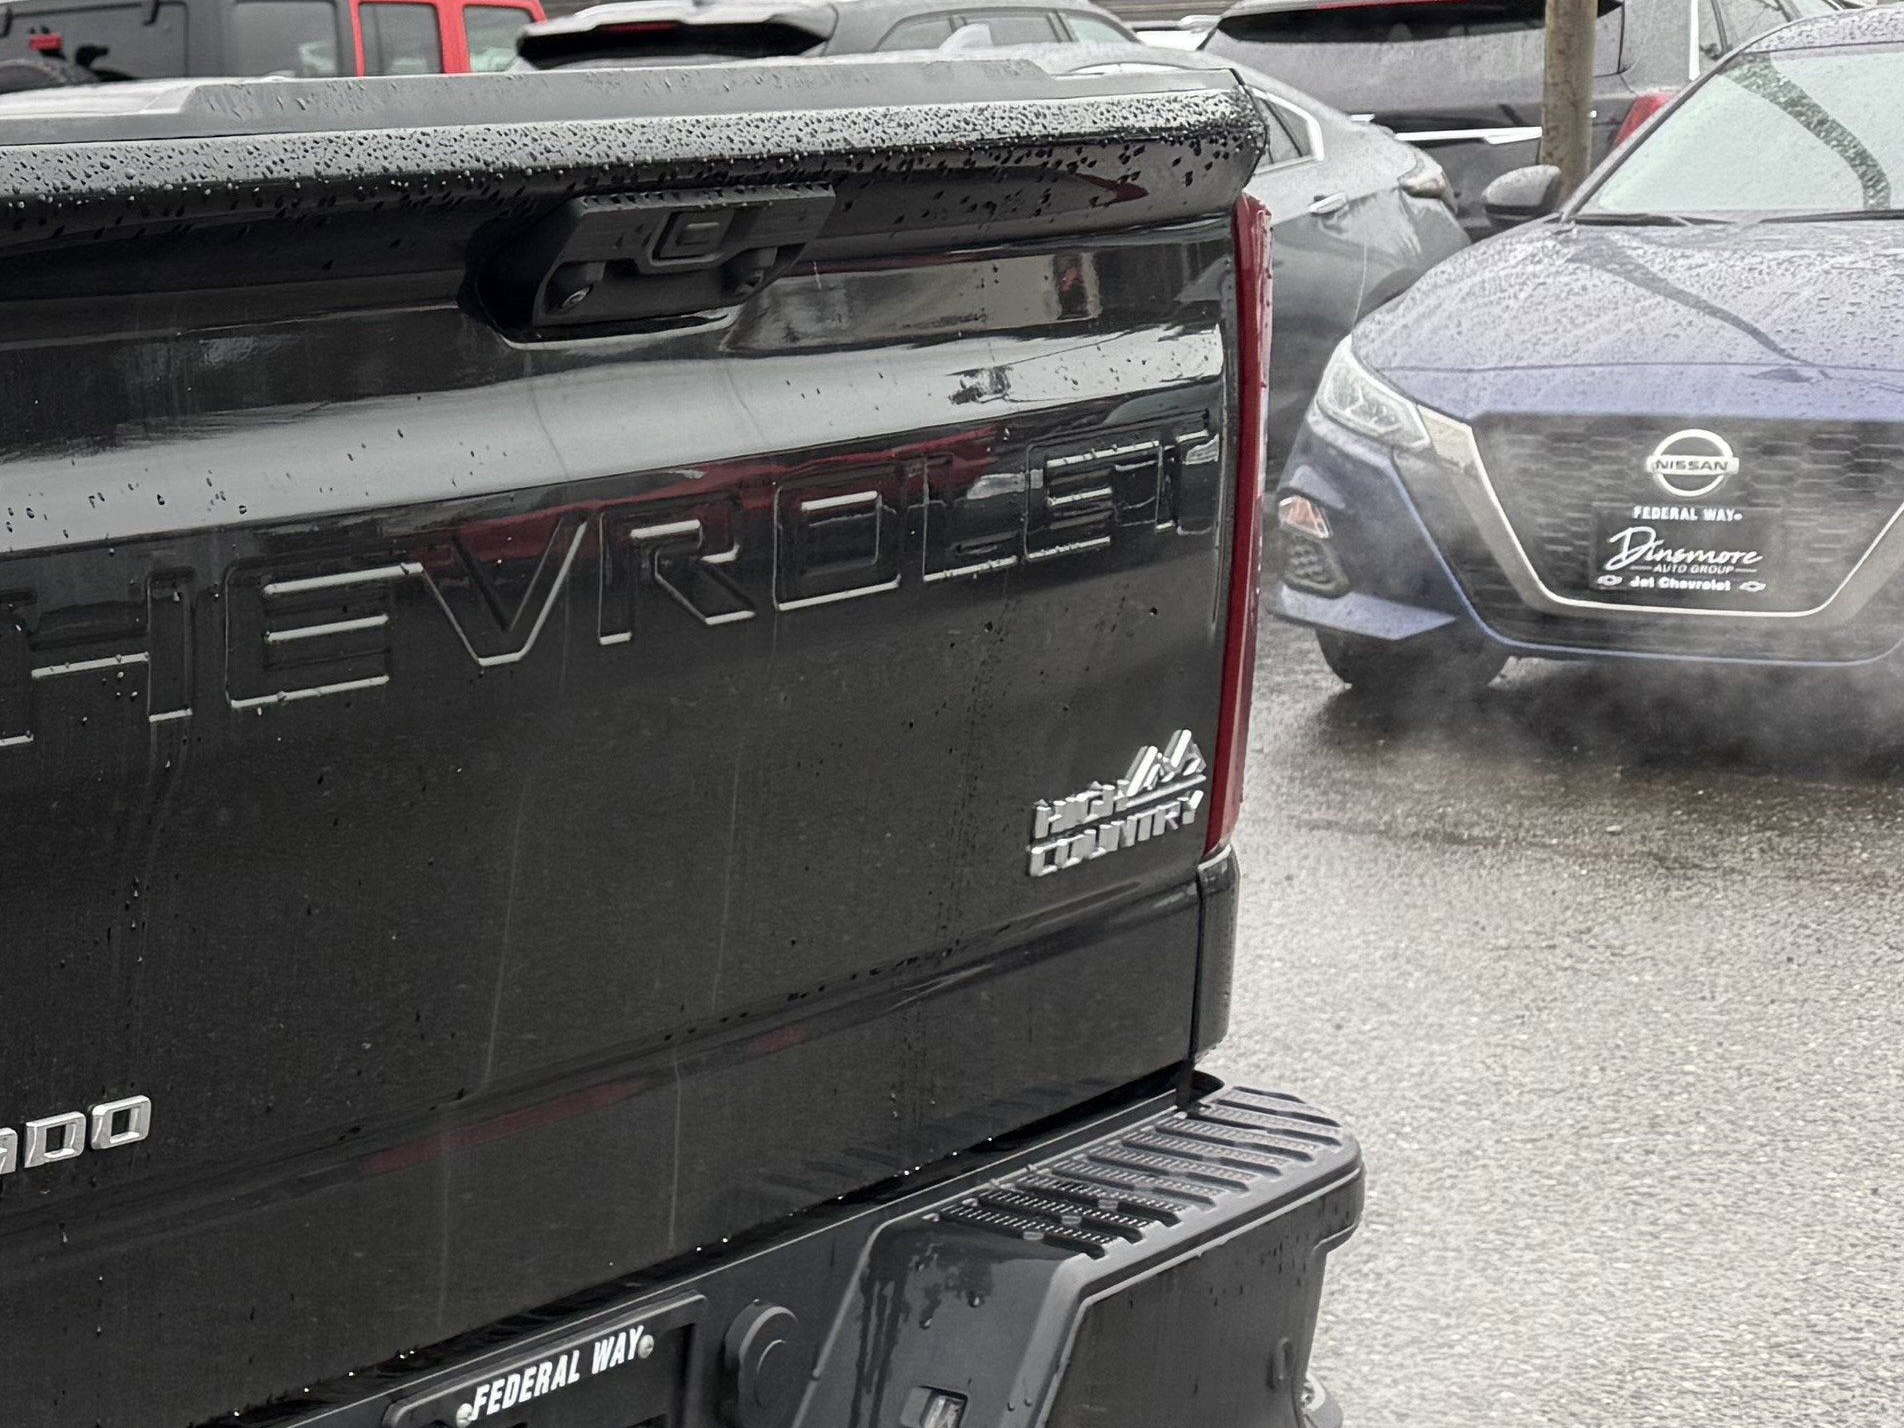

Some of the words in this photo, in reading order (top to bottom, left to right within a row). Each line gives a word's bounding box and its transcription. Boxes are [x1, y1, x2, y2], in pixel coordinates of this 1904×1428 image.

[1654, 458, 1729, 472] NISSAN
[1633, 505, 1698, 521] FEDERAL
[1703, 507, 1736, 522] WAY
[1603, 525, 1764, 572] Dinsmore
[1630, 575, 1655, 589] Jet
[1658, 576, 1732, 591] Chevrolet
[1653, 564, 1688, 574] AUTO
[1690, 564, 1735, 575] GROUP
[1034, 779, 1128, 840] HIGH
[1030, 789, 1204, 877] COUNTRY
[471, 1349, 580, 1422] FEDERAL
[591, 1324, 645, 1375] WAY
